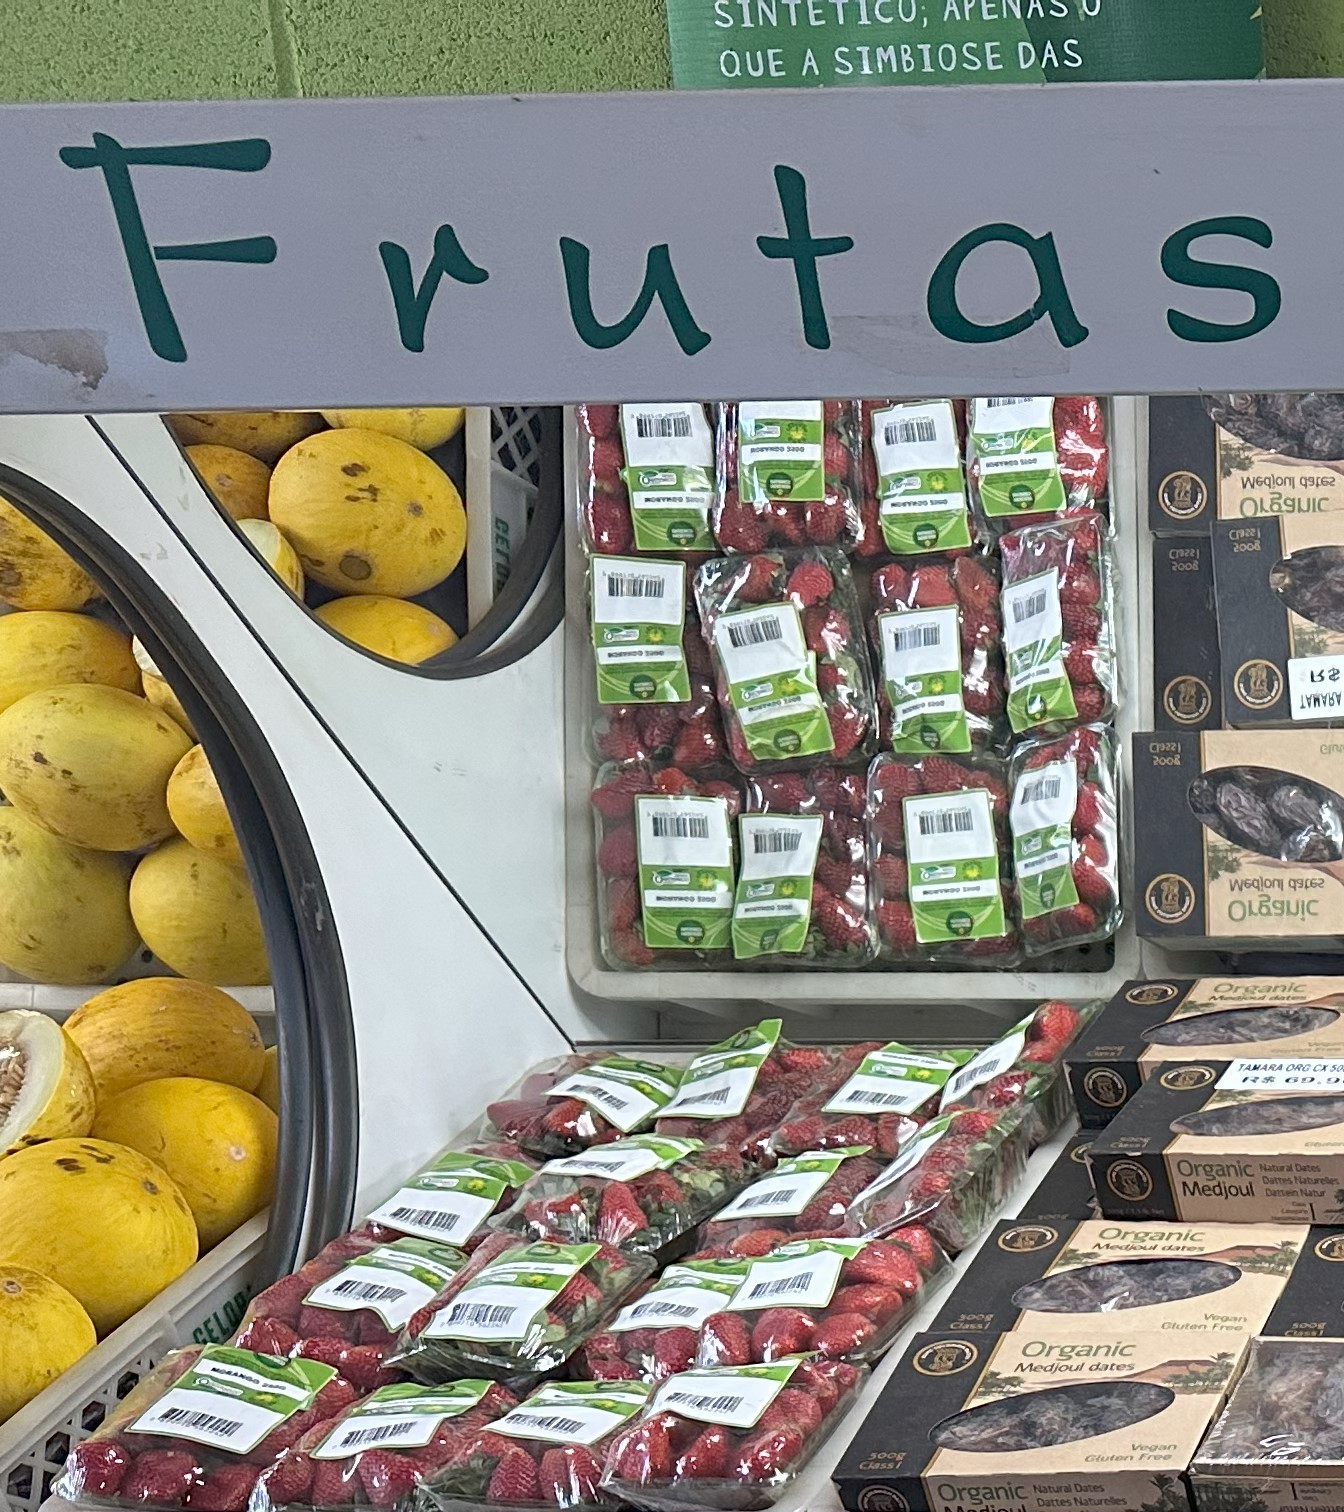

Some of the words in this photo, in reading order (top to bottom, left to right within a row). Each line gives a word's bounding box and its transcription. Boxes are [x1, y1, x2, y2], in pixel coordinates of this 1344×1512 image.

[942, 0, 1068, 20] APENAS
[719, 47, 786, 78] QUE
[801, 46, 820, 75] A
[834, 41, 1003, 76] SIMBIOSE
[1018, 39, 1083, 69] DAS
[60, 132, 1089, 363] Frutas
[1213, 982, 1307, 995] Organic
[1237, 1063, 1283, 1072] TAMARA
[1286, 1063, 1311, 1072] ORG
[1314, 1063, 1328, 1072] CX
[1241, 1076, 1276, 1085] R$
[1177, 1160, 1254, 1181] Organic
[1259, 1163, 1292, 1172] Natural
[1296, 1163, 1320, 1172] Dates
[1182, 1181, 1255, 1200] Medjoul
[1099, 1228, 1205, 1245] Organic
[1091, 1243, 1154, 1253] Medjoul
[1159, 1243, 1204, 1252] dates
[1022, 1341, 1136, 1361] Organic
[1014, 1361, 1084, 1374] Medjoul
[1089, 1361, 1135, 1372] dates
[211, 1367, 260, 1385] MORANGO
[1131, 1443, 1177, 1453] Vegan
[869, 1452, 906, 1461] 500g
[1085, 1454, 1133, 1463] Gluten
[1139, 1453, 1172, 1462] Free
[859, 1460, 894, 1470] Class
[938, 1483, 1028, 1504] Organic
[1034, 1484, 1073, 1493] Natural
[1078, 1484, 1105, 1493] Dates
[1037, 1497, 1071, 1507] Dattes
[1075, 1497, 1127, 1506] Naturelles
